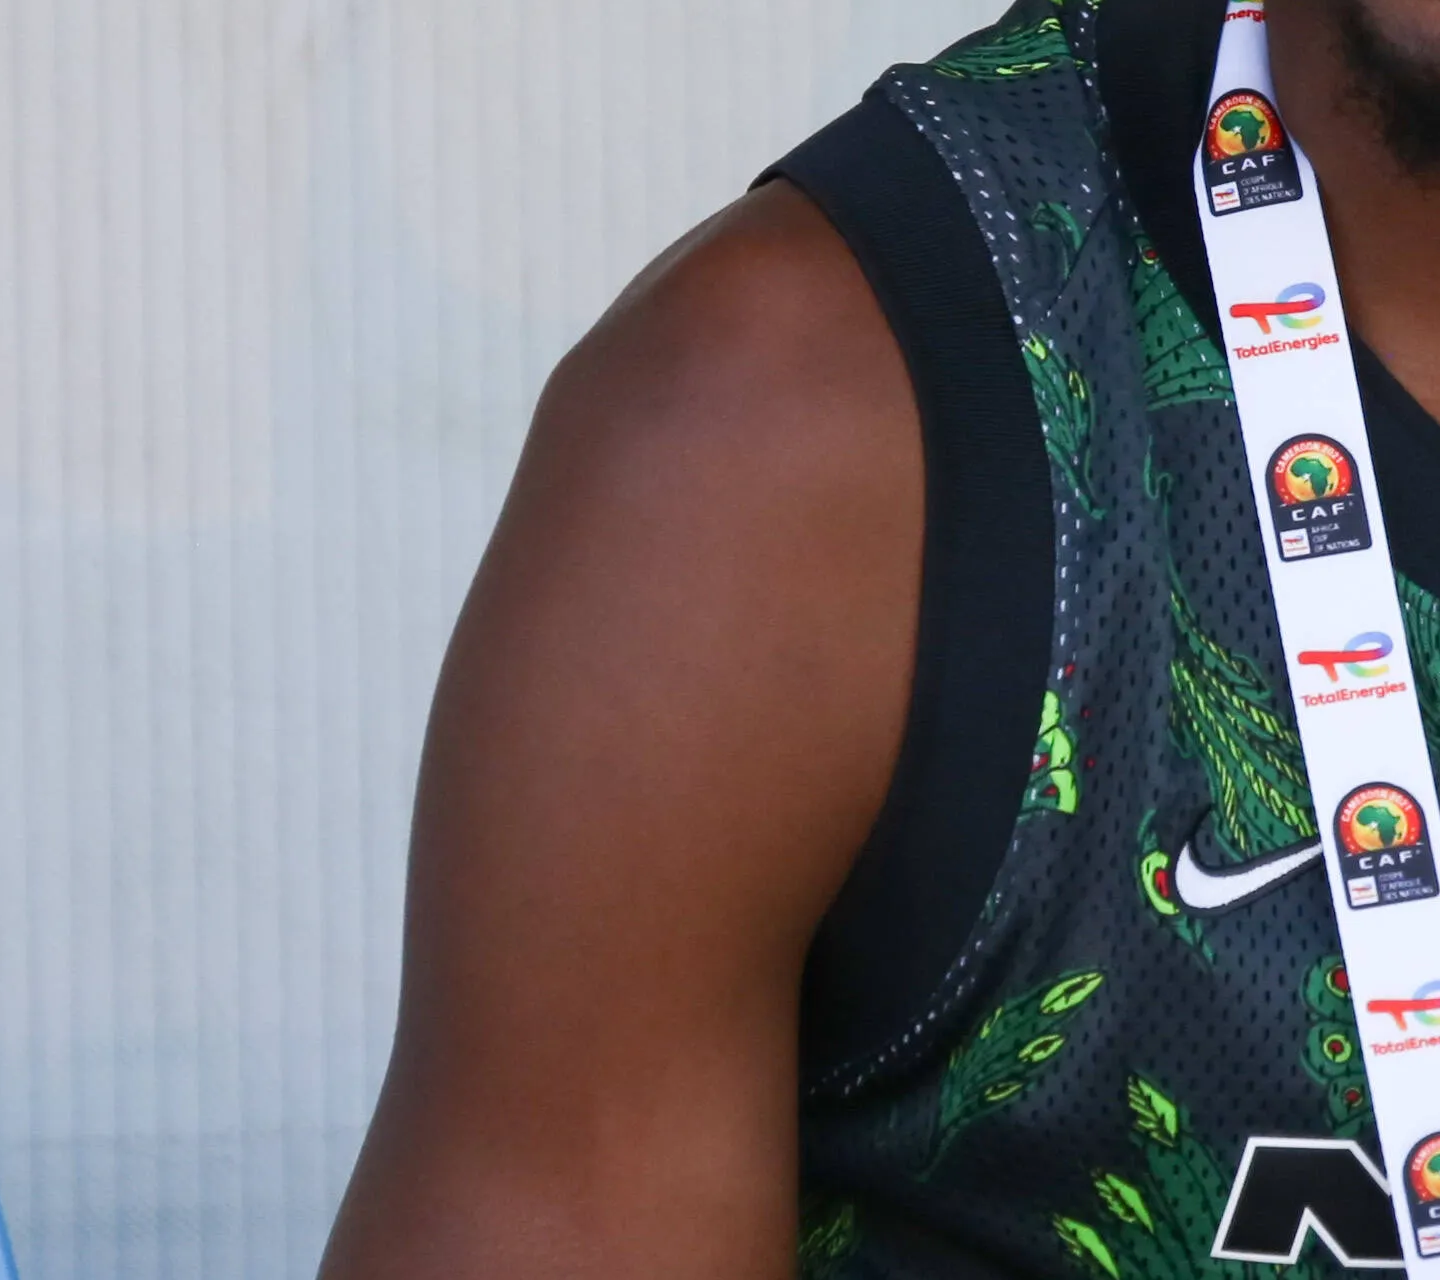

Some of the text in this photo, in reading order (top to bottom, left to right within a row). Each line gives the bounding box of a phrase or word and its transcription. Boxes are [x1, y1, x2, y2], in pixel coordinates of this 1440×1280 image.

[1222, 154, 1275, 175] CAF
[1232, 332, 1340, 360] TotalEnergies
[1275, 441, 1321, 473] CAMEROON
[1291, 502, 1345, 522] CAF
[1300, 681, 1407, 708] TotalEnergies
[1358, 850, 1413, 869] CAF
